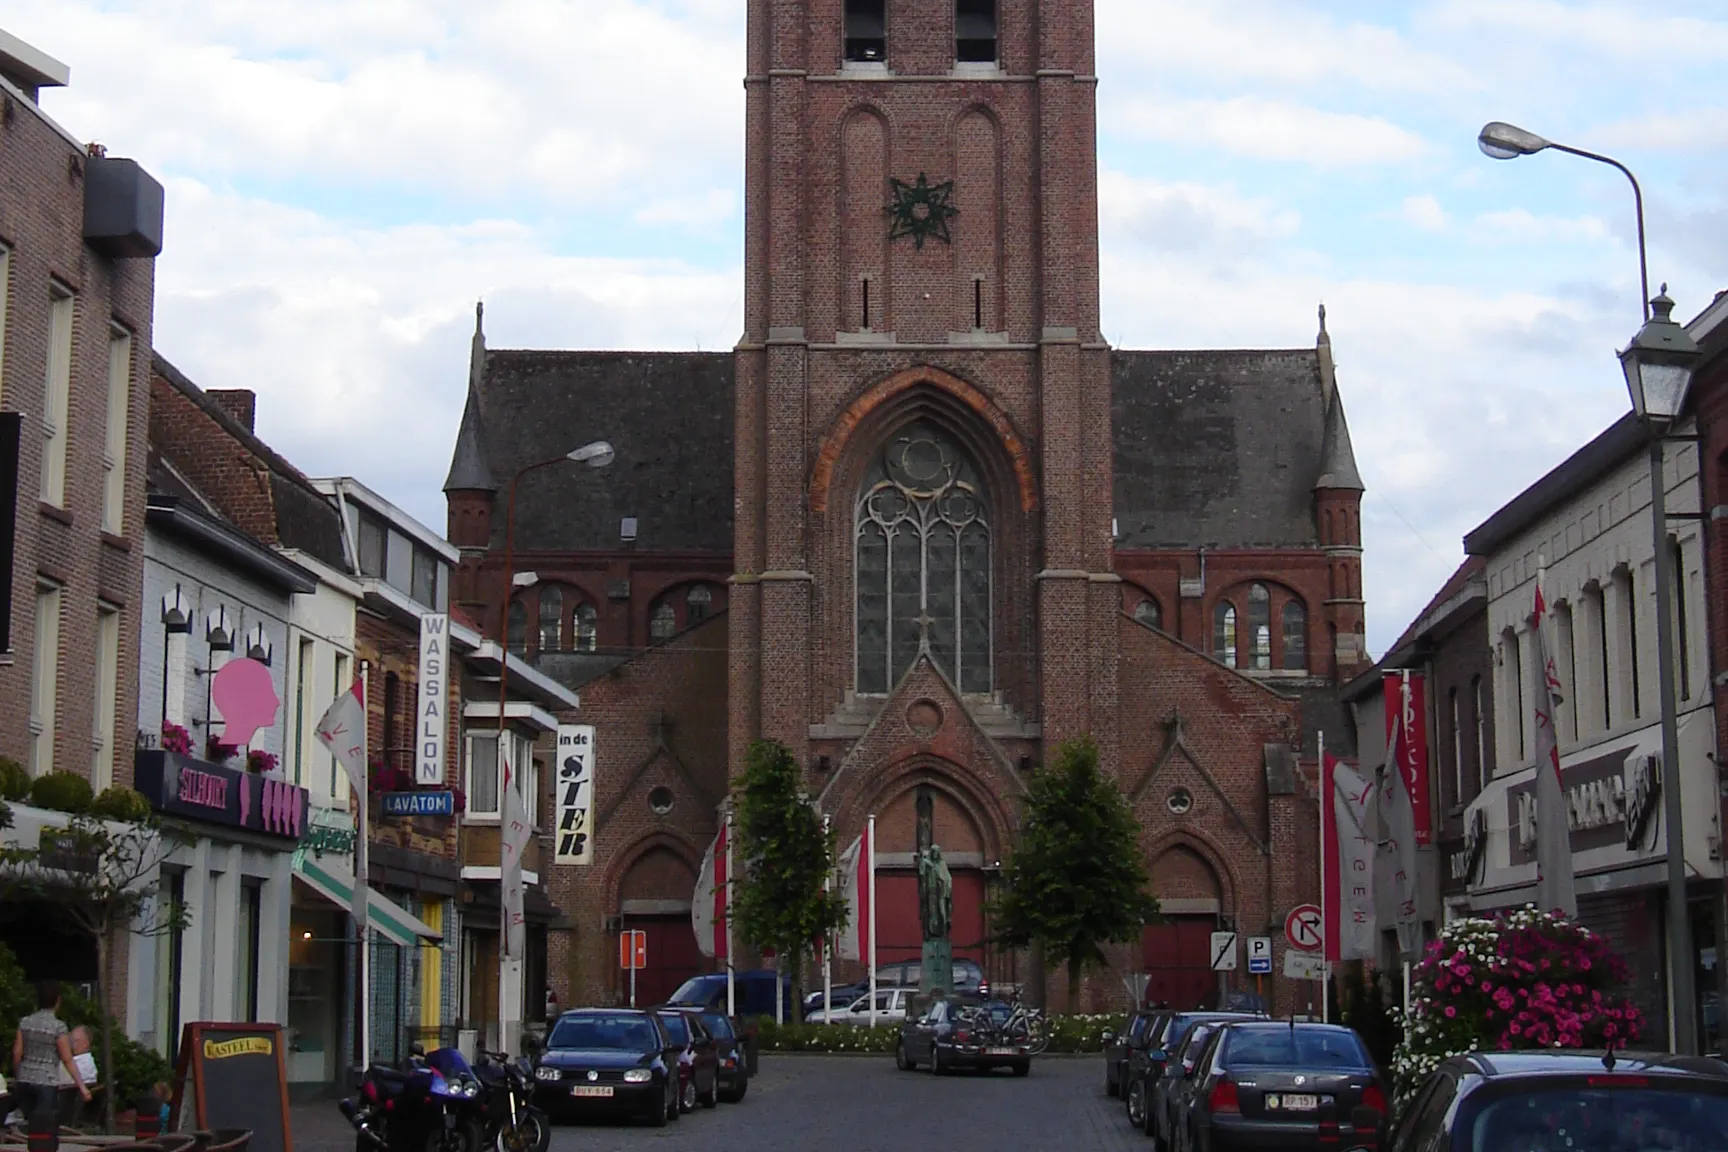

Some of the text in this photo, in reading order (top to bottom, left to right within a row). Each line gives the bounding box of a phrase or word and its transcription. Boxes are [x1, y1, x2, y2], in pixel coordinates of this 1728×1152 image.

[423, 618, 444, 779] WASSALON
[560, 733, 588, 745] in de
[387, 795, 446, 812] LAVATOM
[558, 754, 589, 856] STER
[1254, 941, 1264, 953] P
